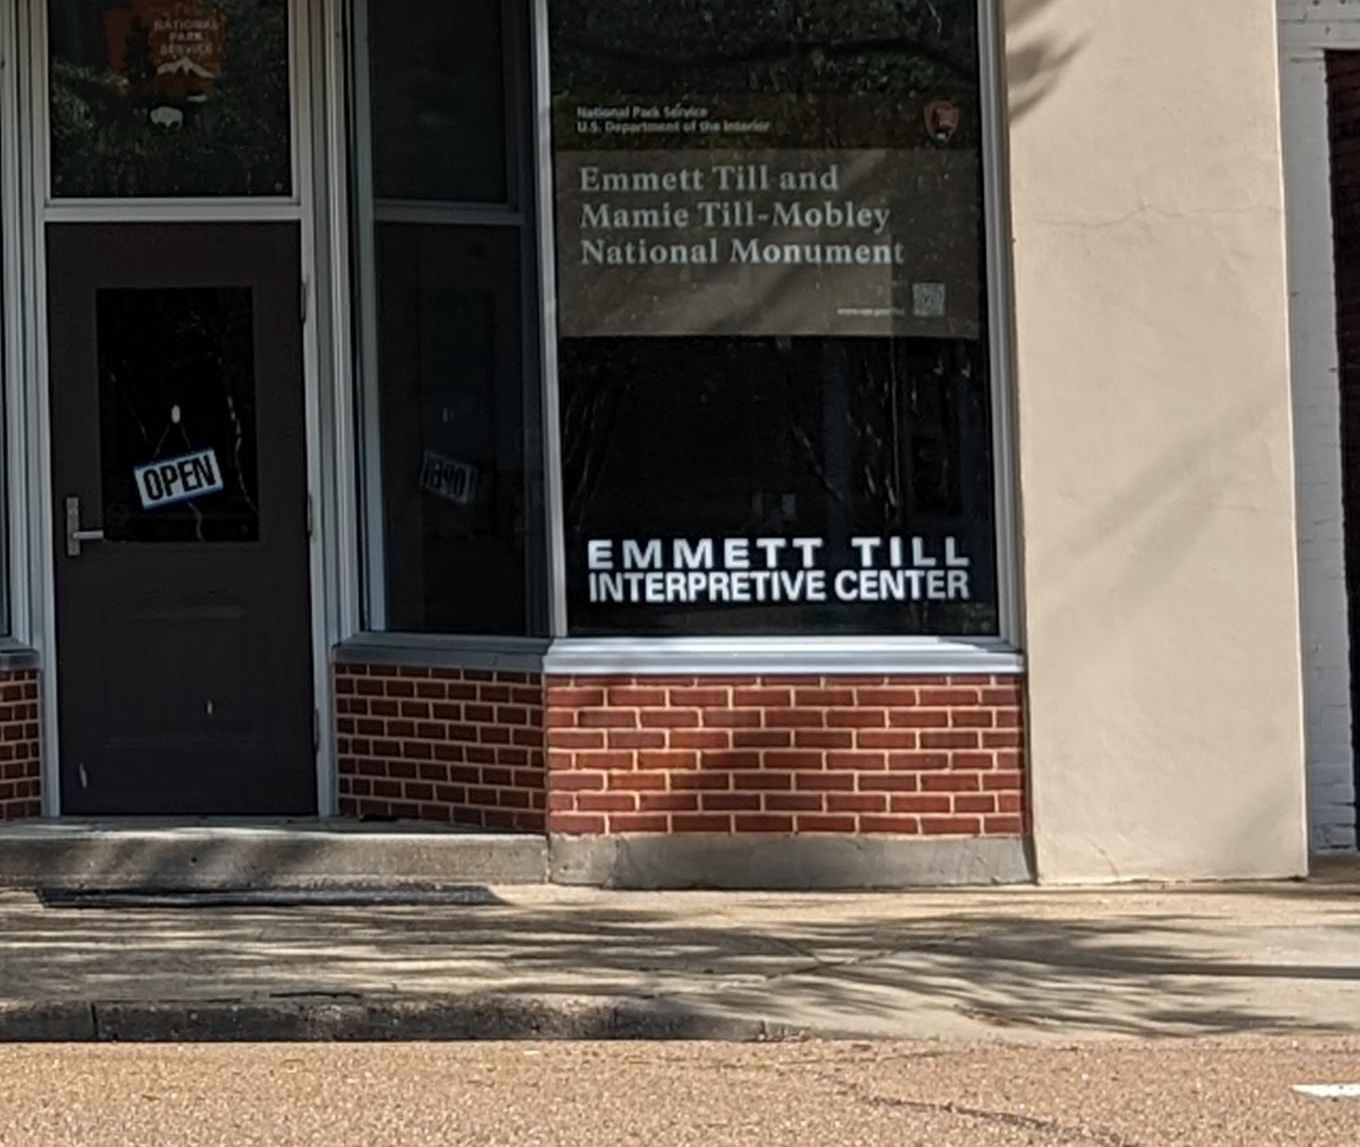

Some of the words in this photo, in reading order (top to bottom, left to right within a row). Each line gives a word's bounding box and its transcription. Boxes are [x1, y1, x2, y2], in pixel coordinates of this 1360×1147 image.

[154, 18, 218, 31] NATIONAL
[168, 32, 203, 42] PARK
[577, 105, 629, 118] National
[633, 105, 660, 118] Park
[664, 104, 708, 118] Service
[577, 120, 601, 133] U.S.
[605, 120, 680, 134] Department
[683, 120, 697, 132] of
[699, 120, 721, 132] the
[724, 120, 770, 132] Interior
[579, 166, 703, 192] Emmett
[712, 164, 769, 191] Till
[779, 164, 839, 191] and
[579, 202, 689, 229] Mamie
[697, 200, 890, 234] Till-Mobley
[579, 238, 718, 265] National
[729, 239, 905, 264] Monument
[143, 455, 216, 500] OPEN
[588, 538, 823, 569] EMMETT
[851, 536, 970, 567] TILL
[589, 570, 826, 602] INTERPRETIVE
[834, 569, 970, 600] CENTER
